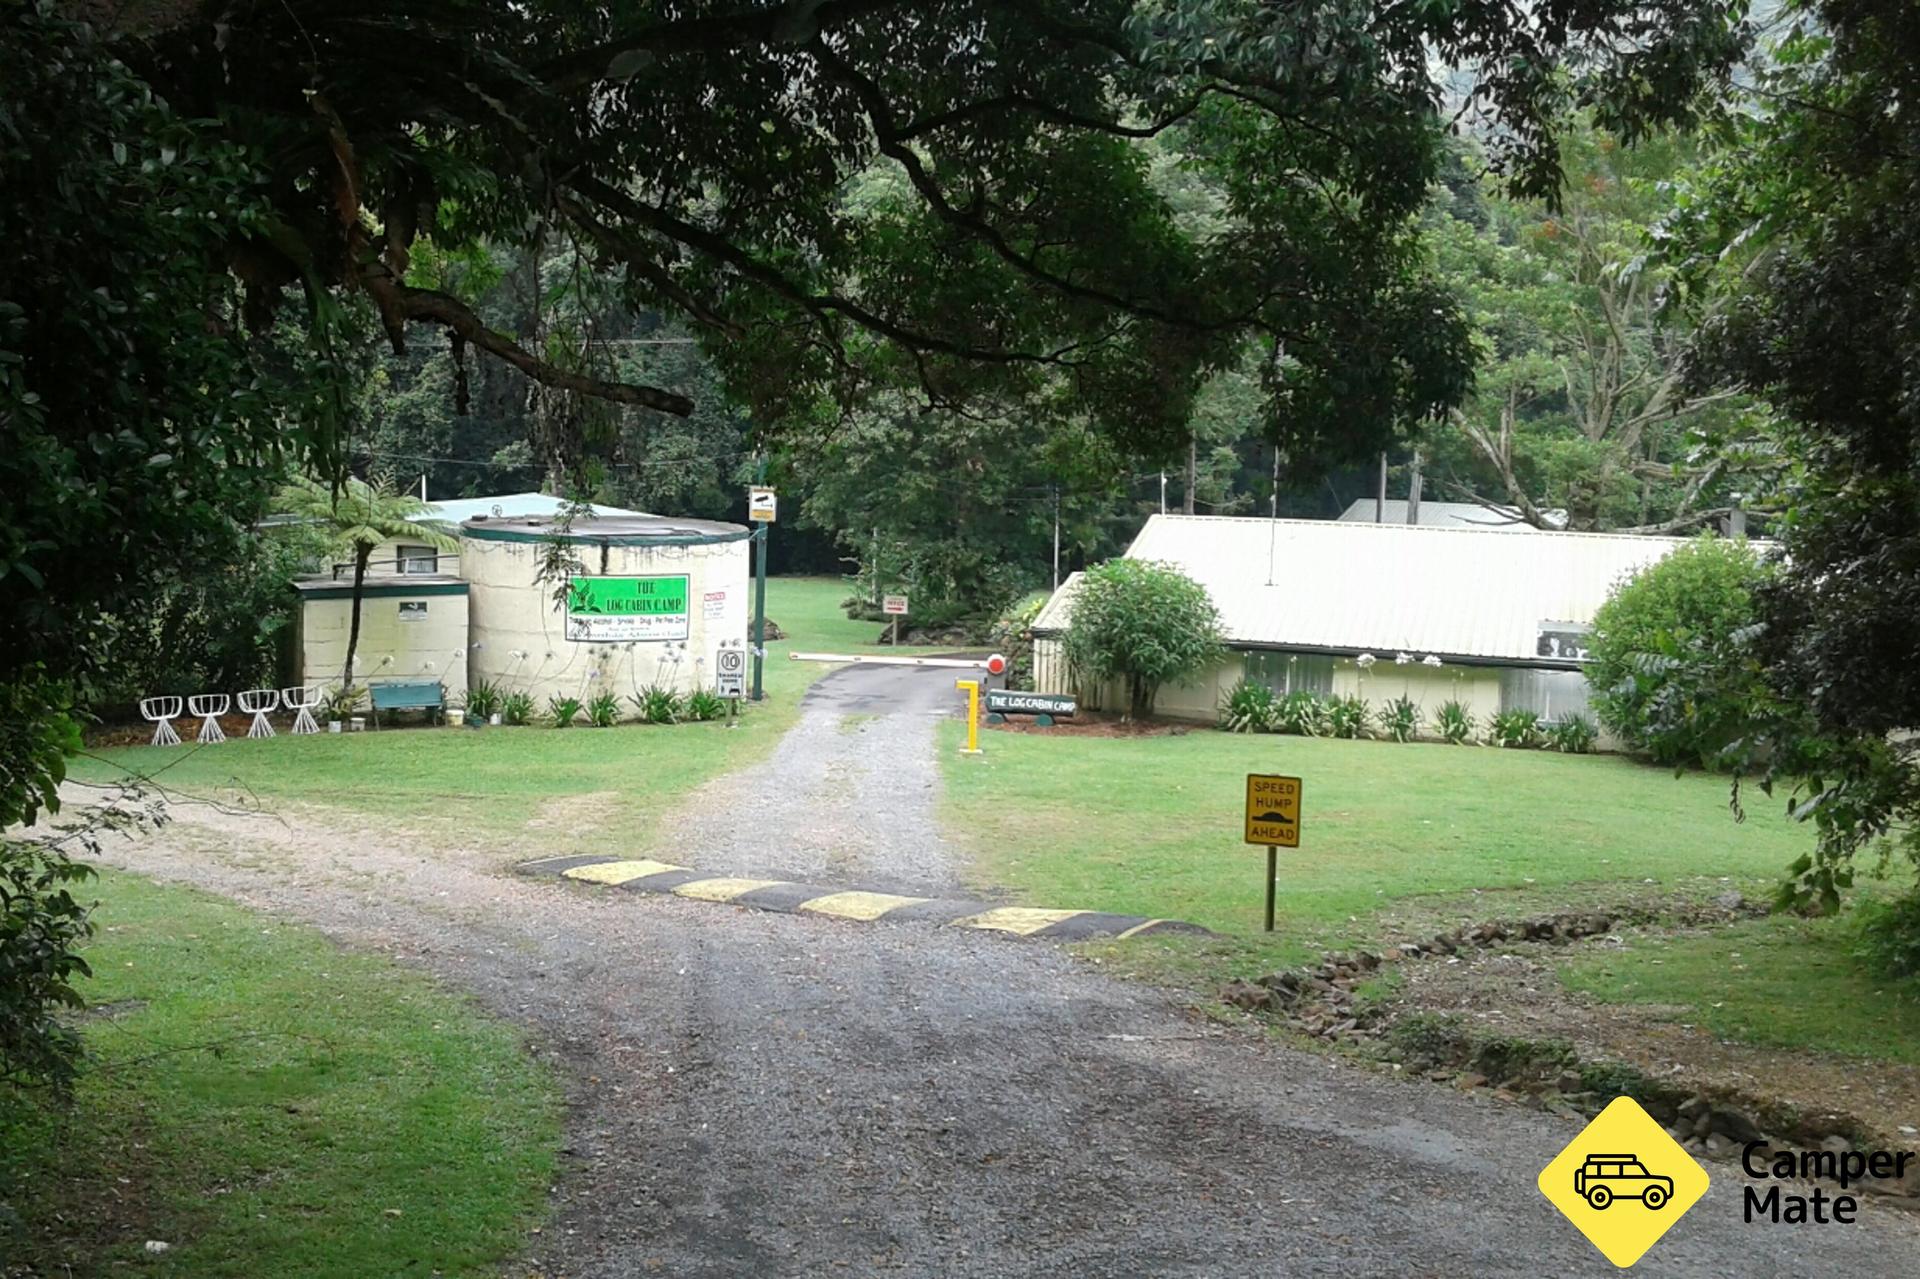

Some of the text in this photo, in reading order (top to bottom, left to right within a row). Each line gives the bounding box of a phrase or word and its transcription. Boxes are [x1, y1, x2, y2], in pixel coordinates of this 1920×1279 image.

[637, 581, 655, 594] THE
[607, 598, 682, 612] LOG CABIN CAMP
[725, 655, 738, 668] 10
[990, 695, 1076, 712] THE LOG CABIN CAMP
[1254, 781, 1295, 795] SPEED
[1256, 797, 1292, 809] HUMP
[1251, 826, 1295, 840] AHEAD
